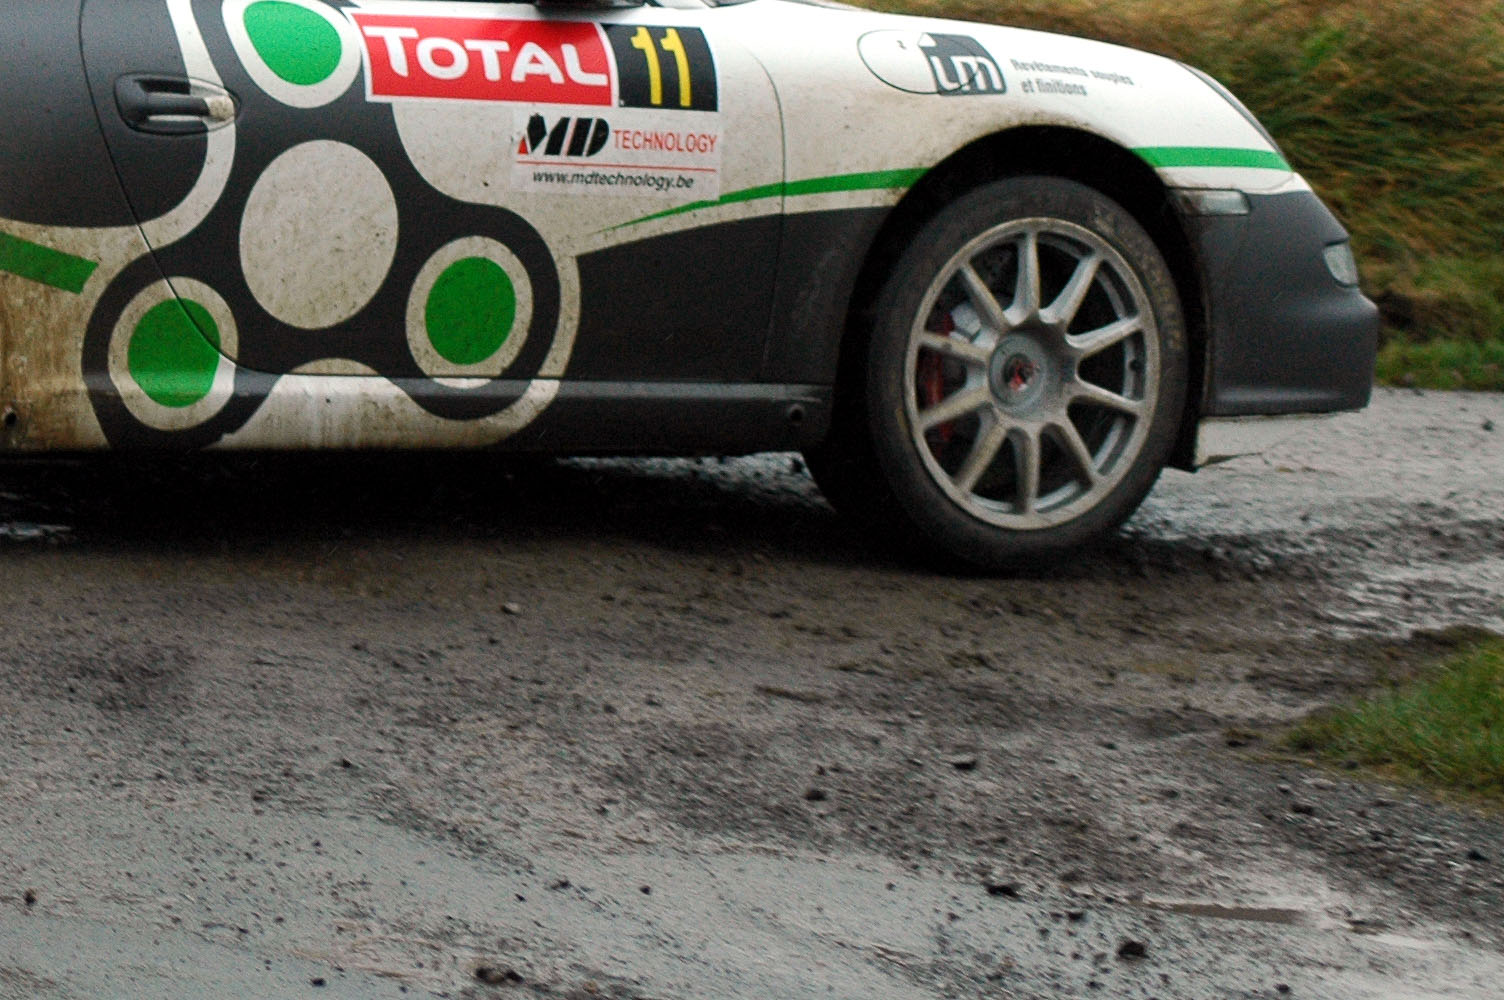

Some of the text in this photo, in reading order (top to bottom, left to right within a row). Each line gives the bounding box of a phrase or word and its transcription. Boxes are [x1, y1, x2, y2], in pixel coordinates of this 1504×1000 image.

[362, 25, 608, 86] TOTAL
[630, 26, 691, 107] 11
[614, 130, 717, 154] TECHNOLOGY
[533, 171, 694, 191] www.mdtechnology.be
